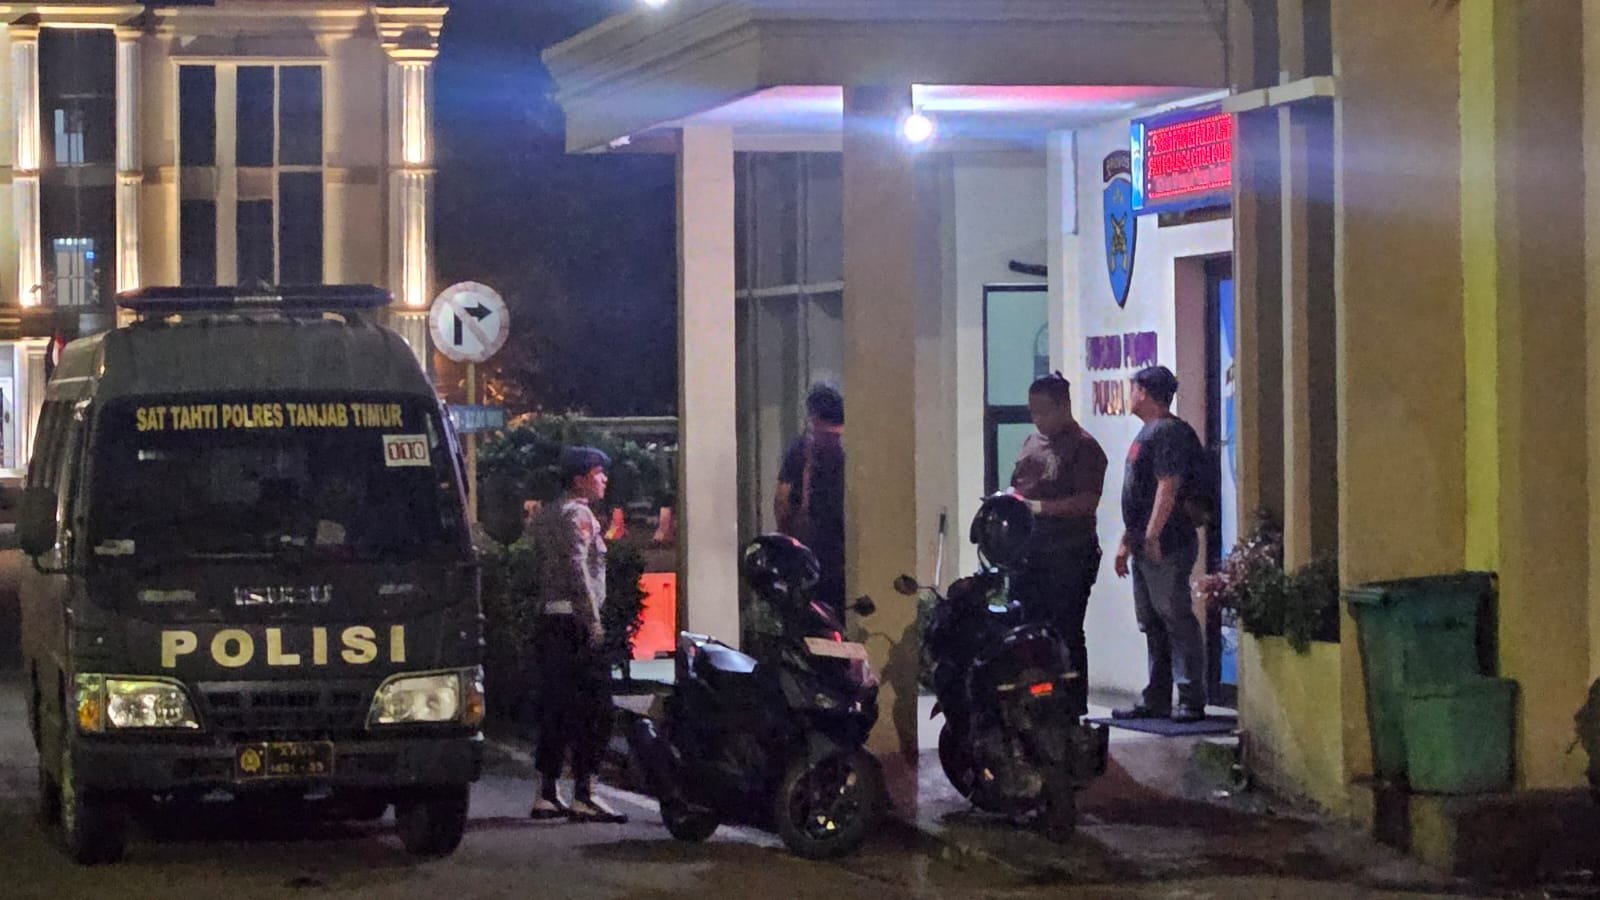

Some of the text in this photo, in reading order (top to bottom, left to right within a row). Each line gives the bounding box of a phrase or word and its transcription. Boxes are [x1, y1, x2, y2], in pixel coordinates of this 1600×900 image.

[136, 403, 403, 432] SAT TAHTI POLRES TANJAB TIMUR
[388, 441, 425, 460] 110
[160, 625, 406, 668] POLISI
